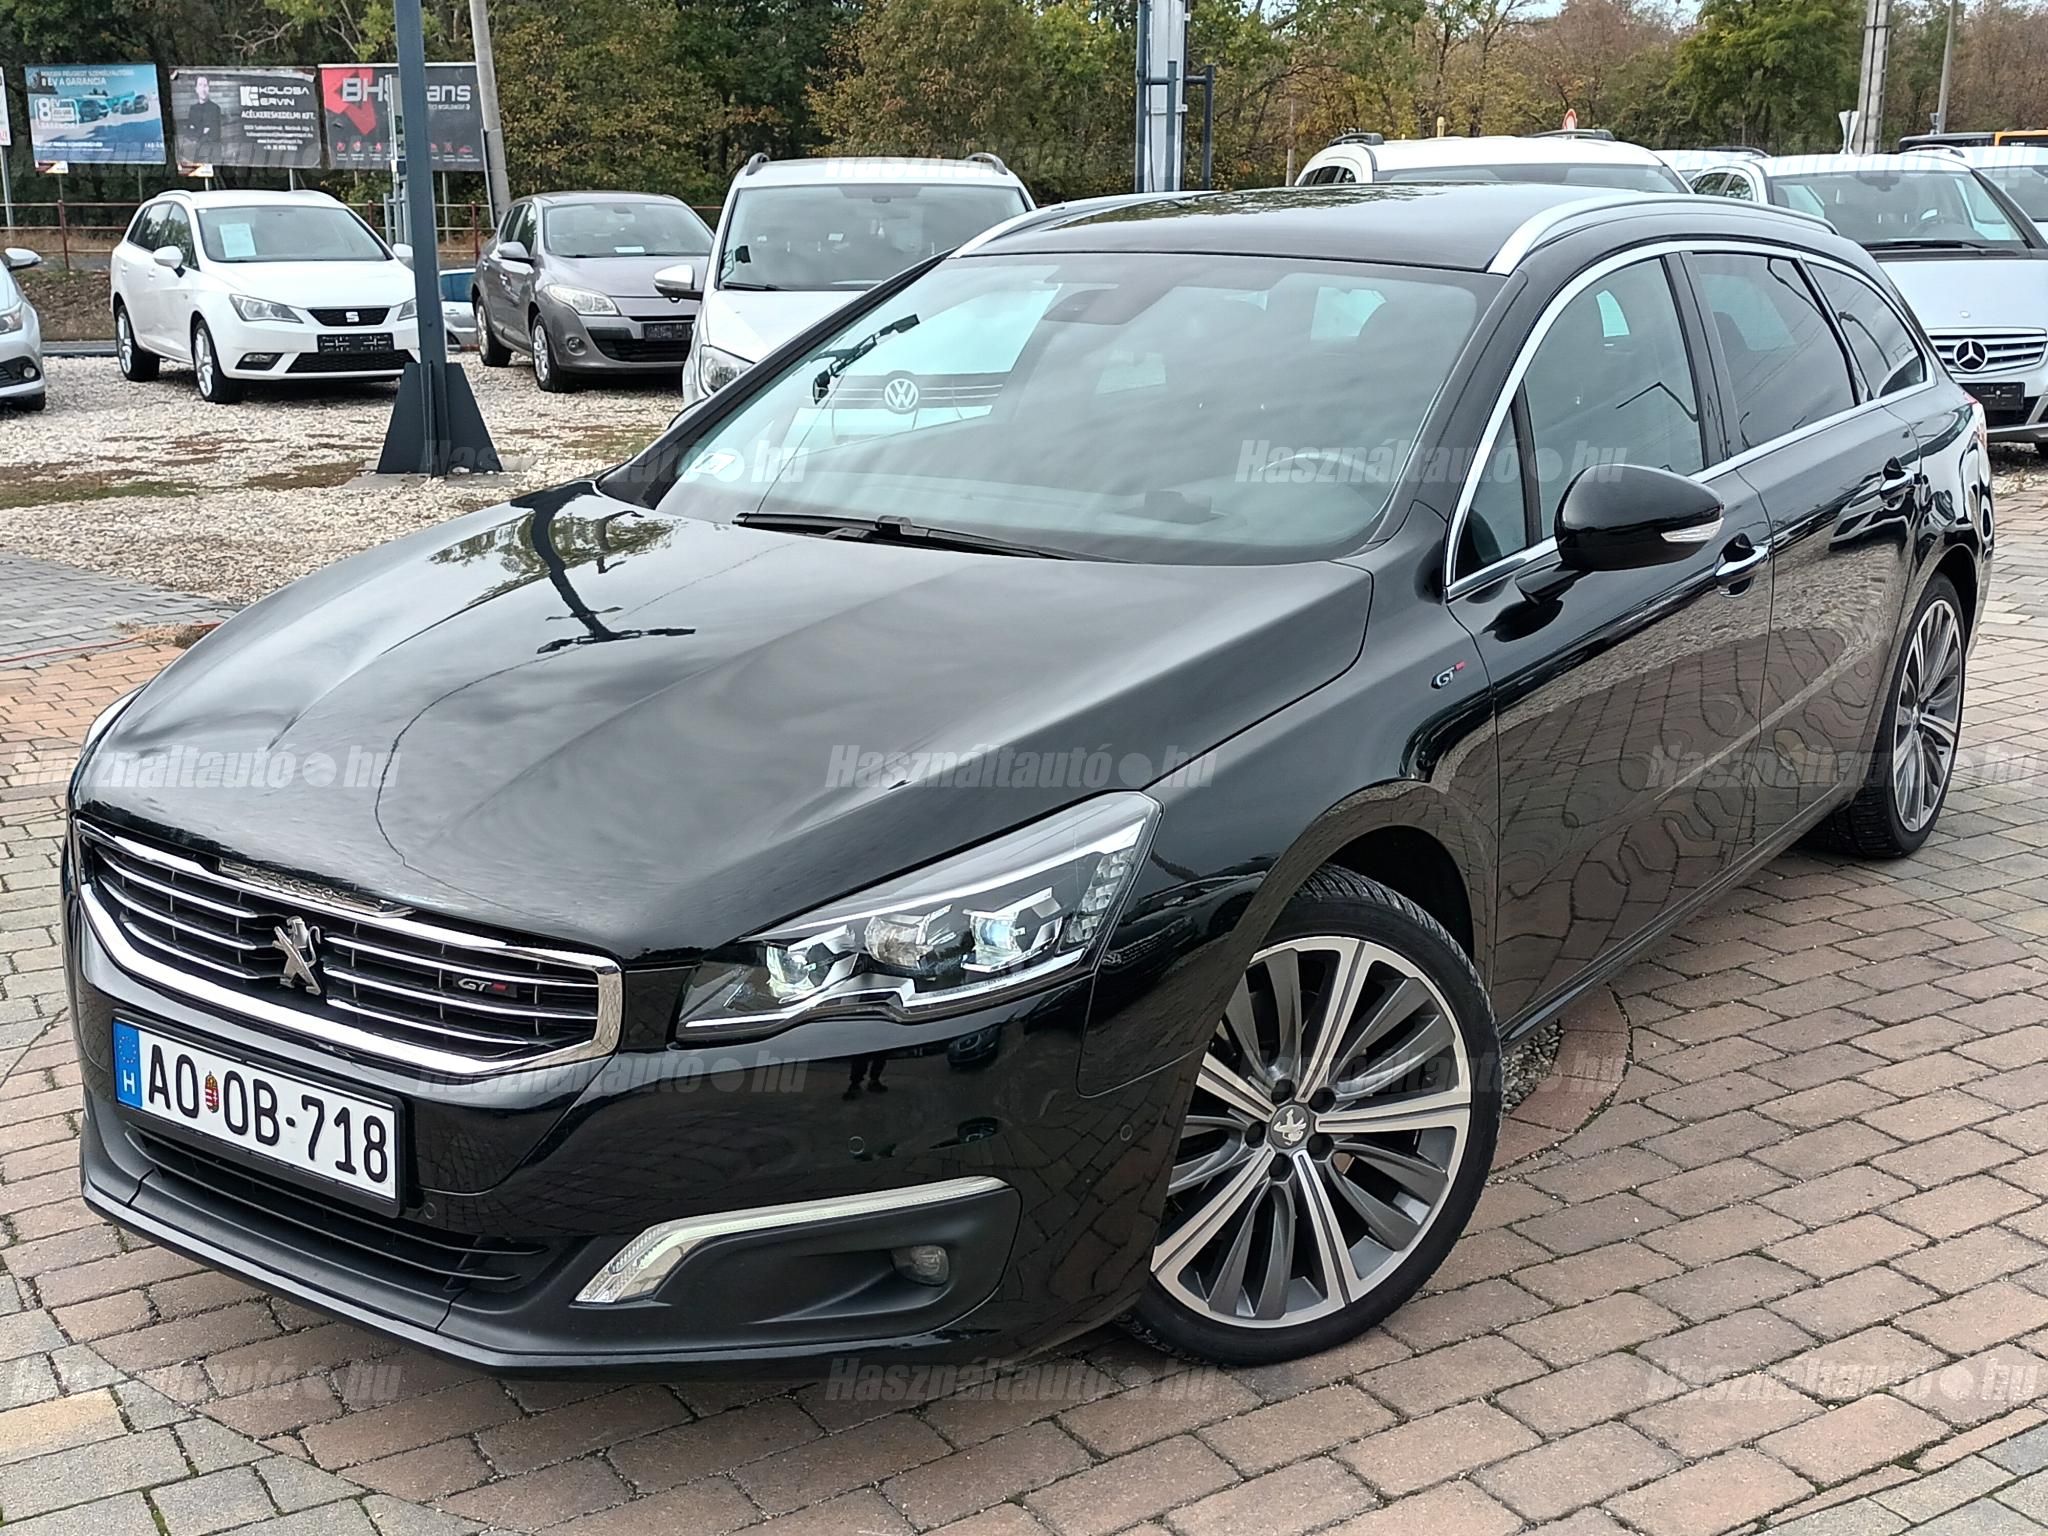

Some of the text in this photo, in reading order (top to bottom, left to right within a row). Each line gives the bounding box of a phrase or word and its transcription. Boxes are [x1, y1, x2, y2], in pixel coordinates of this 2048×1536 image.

[342, 78, 471, 102] BH ans
[38, 97, 51, 121] 8
[122, 1069, 137, 1095] H
